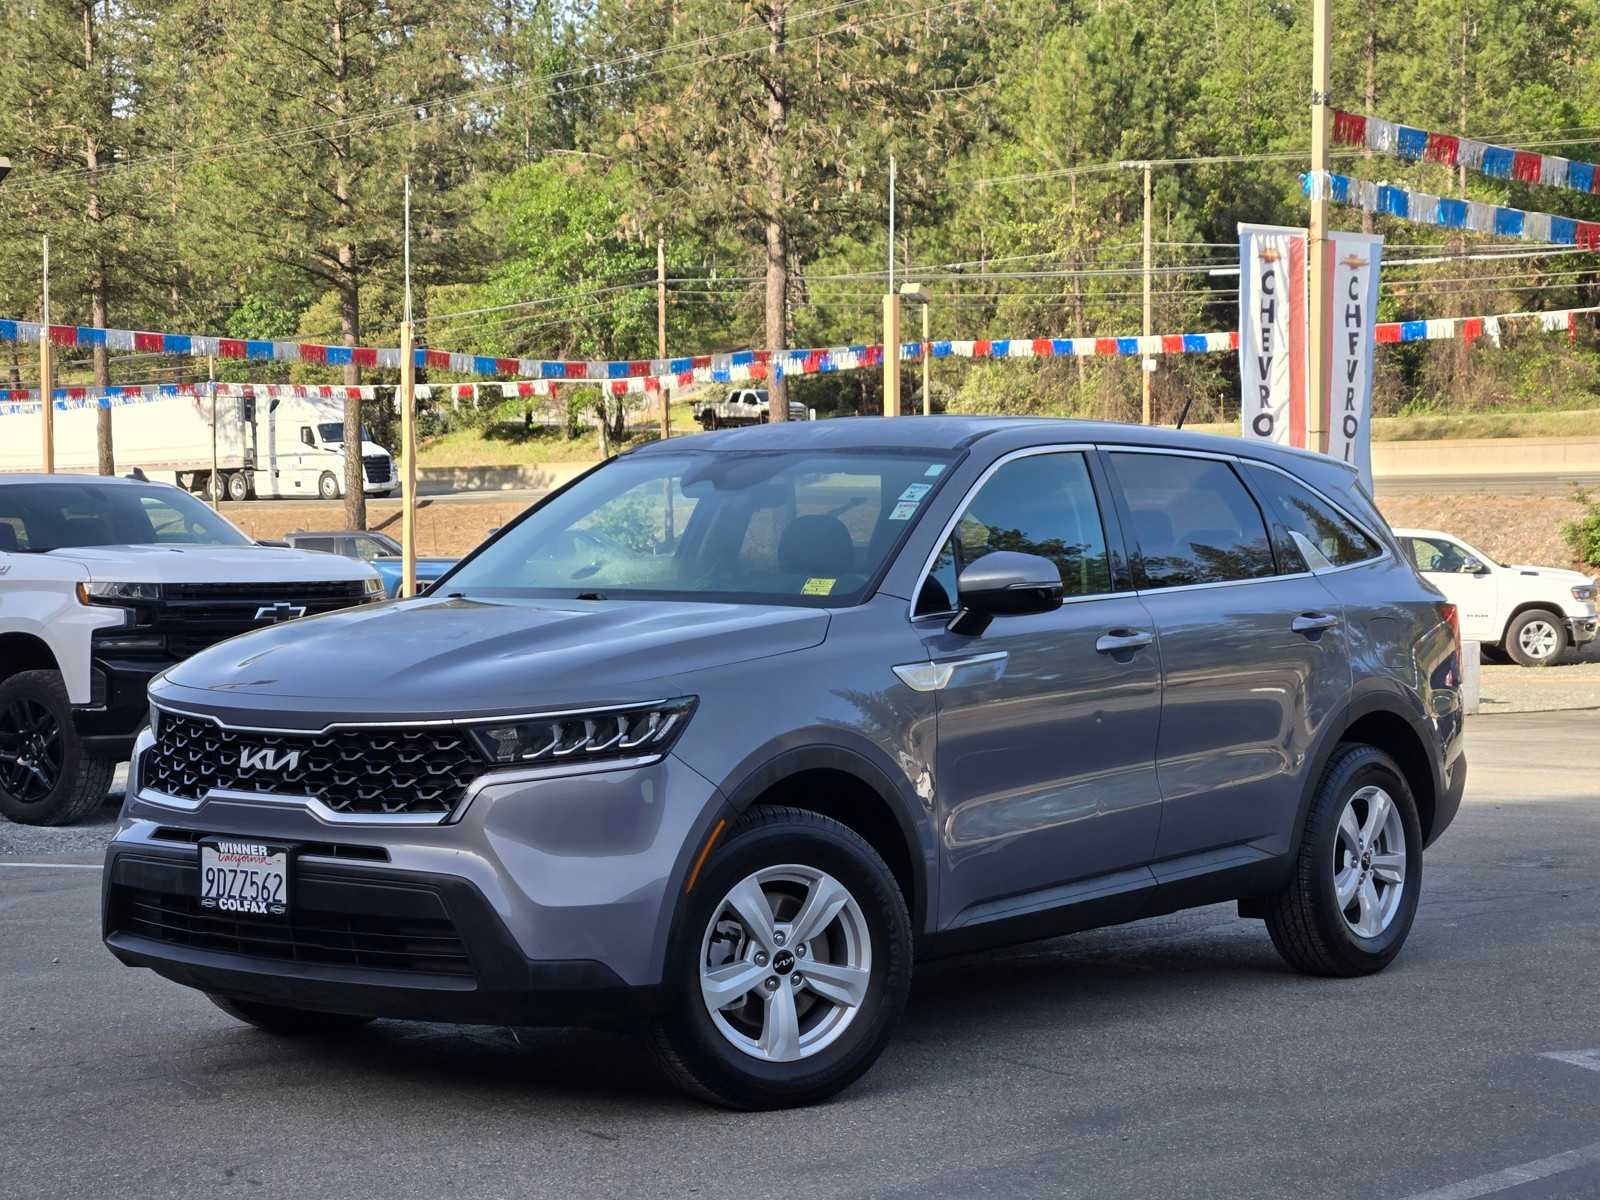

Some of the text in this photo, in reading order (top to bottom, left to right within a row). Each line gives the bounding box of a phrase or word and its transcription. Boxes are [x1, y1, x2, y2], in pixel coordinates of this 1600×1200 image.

[240, 748, 299, 771] KIA
[218, 842, 268, 856] WINNER
[205, 867, 283, 903] 9DZZ562
[219, 899, 268, 913] COLFAX
